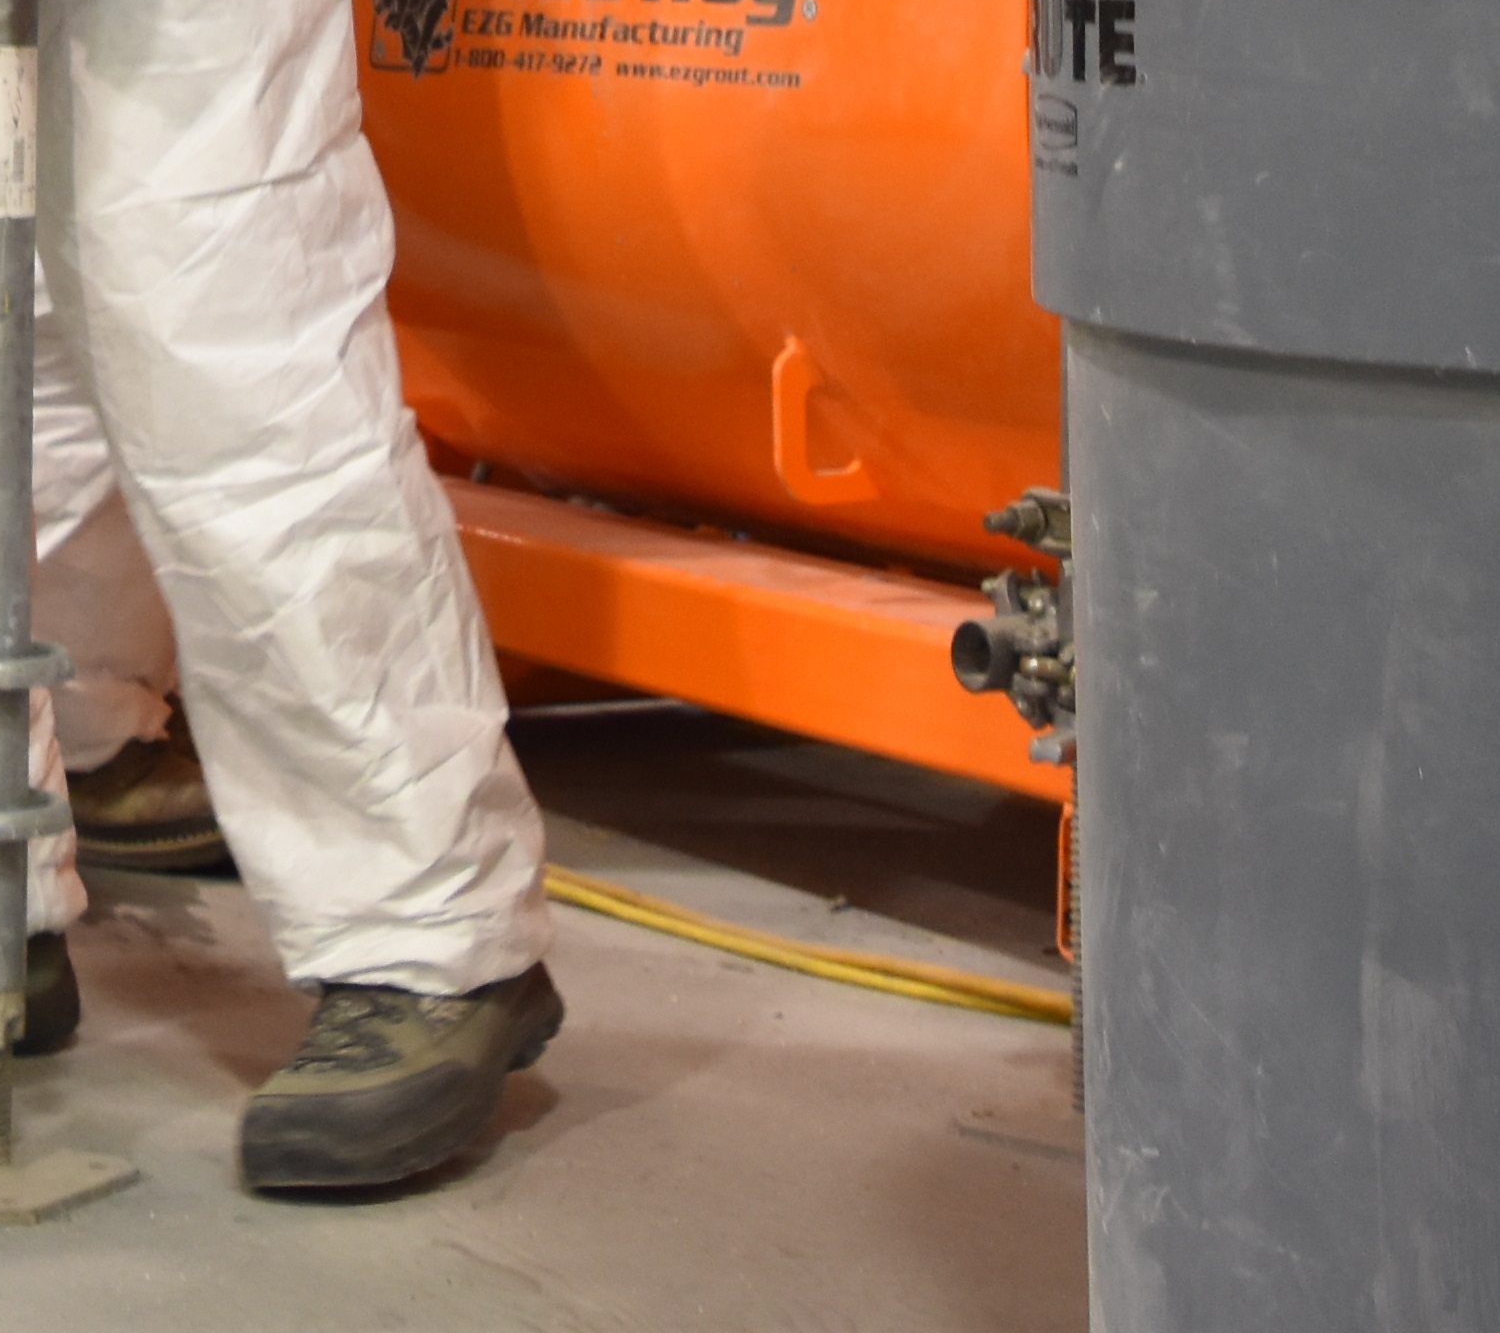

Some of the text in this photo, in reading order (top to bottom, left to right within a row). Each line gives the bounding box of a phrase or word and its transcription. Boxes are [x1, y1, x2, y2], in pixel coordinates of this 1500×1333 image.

[462, 8, 745, 57] EZG Manufacturing
[454, 46, 802, 89] 1-800-417-9272 www.ezgrout.com
